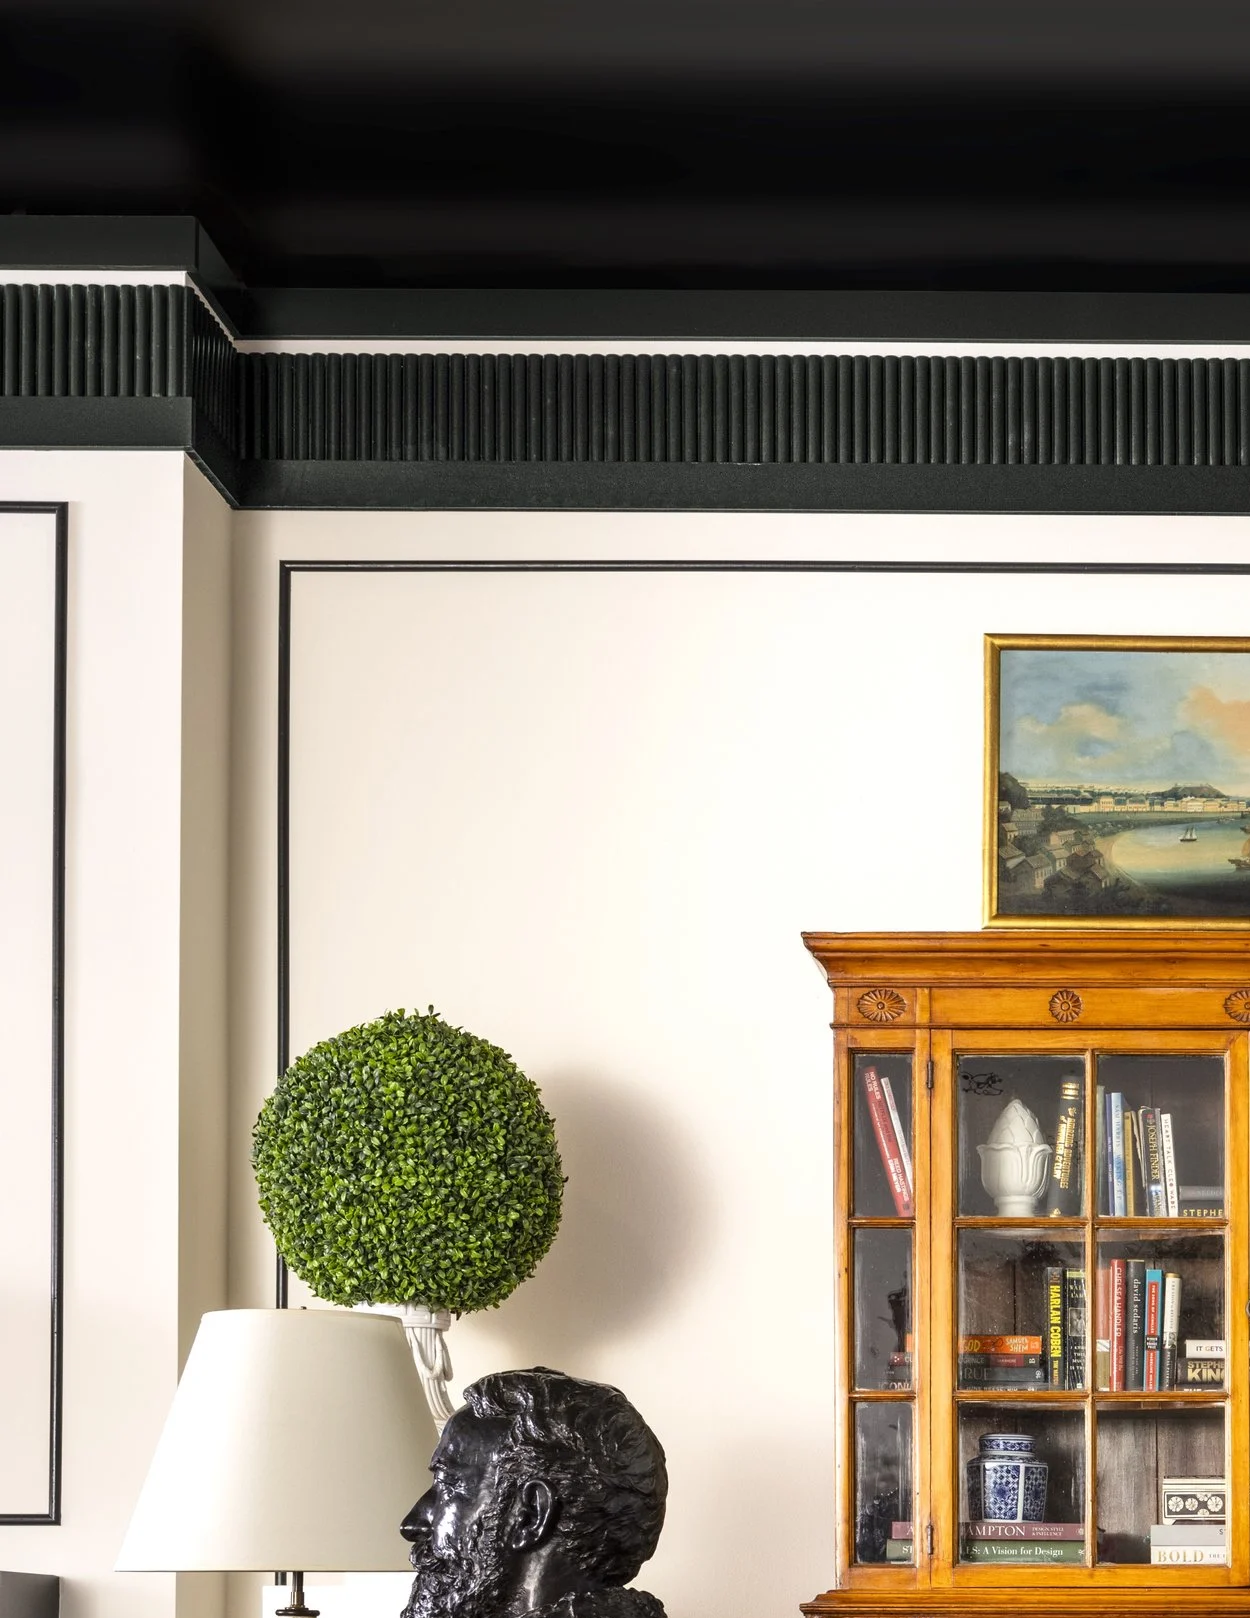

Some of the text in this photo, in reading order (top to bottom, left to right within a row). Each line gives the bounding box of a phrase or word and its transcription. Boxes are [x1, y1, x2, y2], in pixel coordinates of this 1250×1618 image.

[872, 1080, 881, 1100] RULES
[1147, 1125, 1158, 1151] JOSEPH
[1150, 1153, 1160, 1180] FINDER
[1183, 1209, 1223, 1217] STEPHE
[1050, 1286, 1061, 1324] HARLAN
[1132, 1305, 1140, 1334] sedaris
[1050, 1326, 1061, 1357] COBEN
[1188, 1360, 1224, 1369] STEPHE
[983, 1547, 989, 1555] A
[992, 1546, 1018, 1555] Vision
[1020, 1546, 1032, 1555] for
[1035, 1547, 1063, 1556] Design
[1157, 1550, 1204, 1563] BOLD
